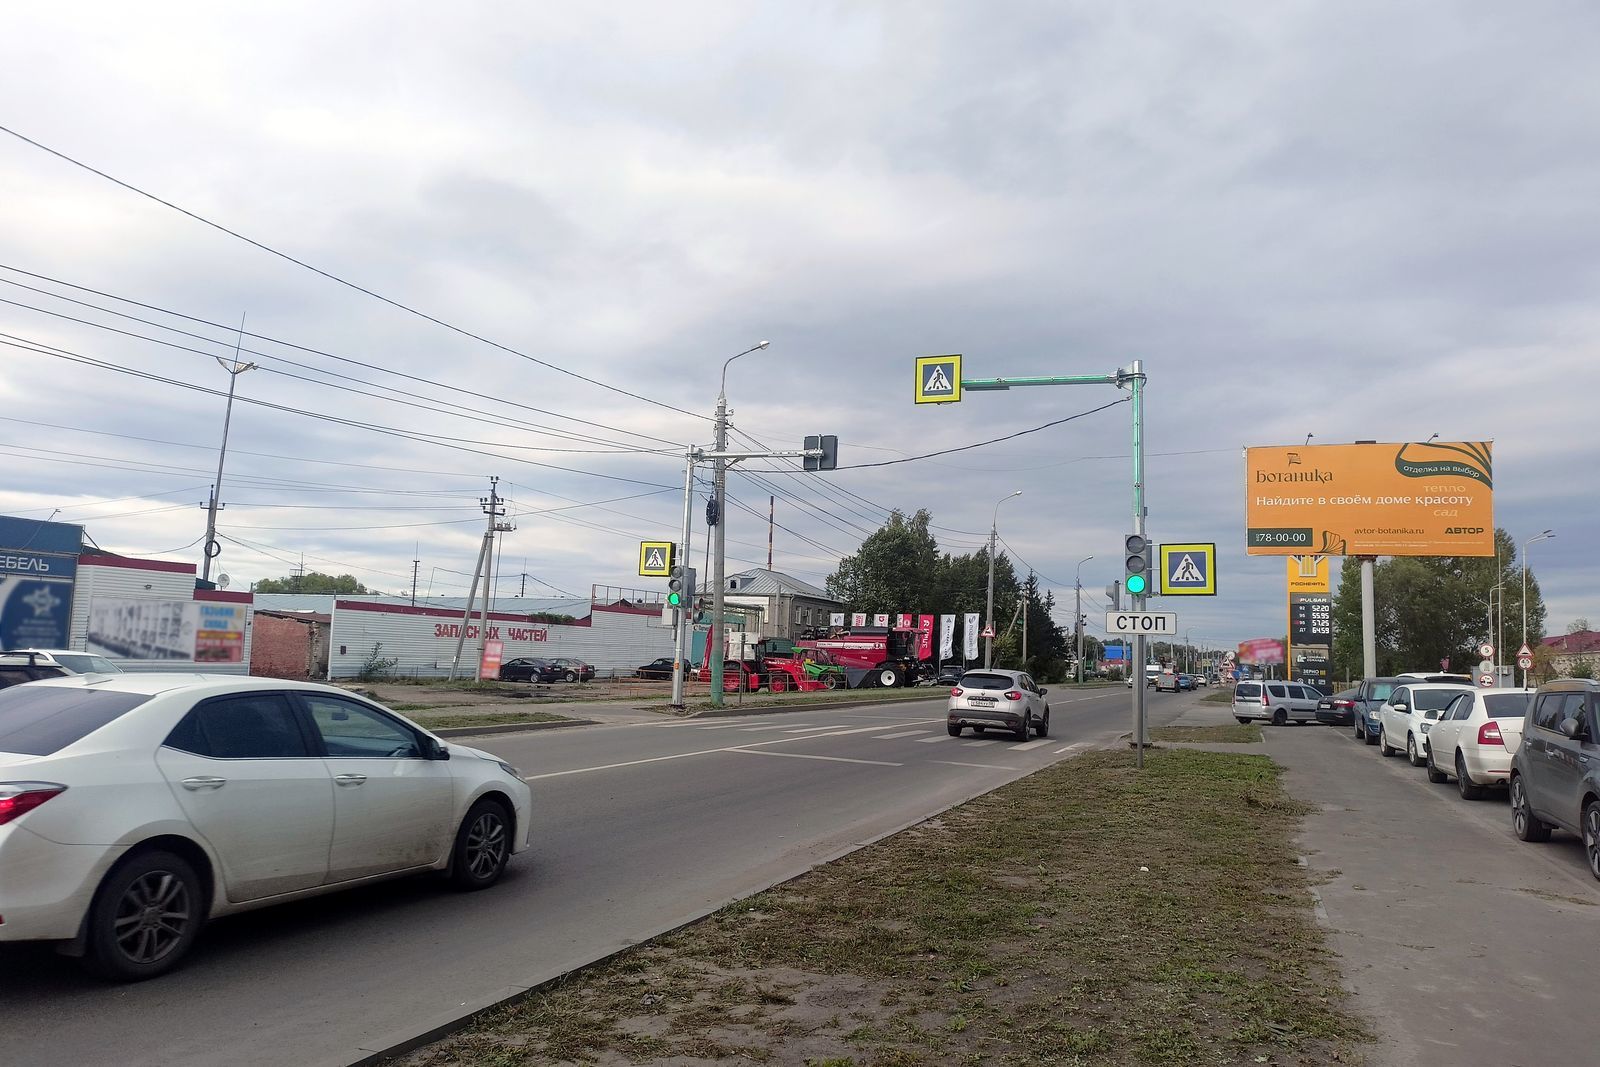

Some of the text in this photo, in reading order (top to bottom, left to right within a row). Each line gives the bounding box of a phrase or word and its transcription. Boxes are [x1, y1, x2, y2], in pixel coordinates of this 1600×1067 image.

[1256, 469, 1333, 484] Ботаника
[1403, 465, 1438, 474] отделка
[1452, 465, 1480, 478] выбор
[1424, 485, 1466, 493] тепло
[1256, 494, 1473, 507] Найдите в своём доме красоту
[1433, 509, 1458, 518] сад
[1354, 527, 1424, 535] avtor-botanika.ru
[1444, 527, 1484, 535] АВТОР
[1259, 533, 1306, 542] 78-00-00
[1116, 615, 1166, 631] СТОП
[508, 627, 548, 642] ЧАСТЕЙ
